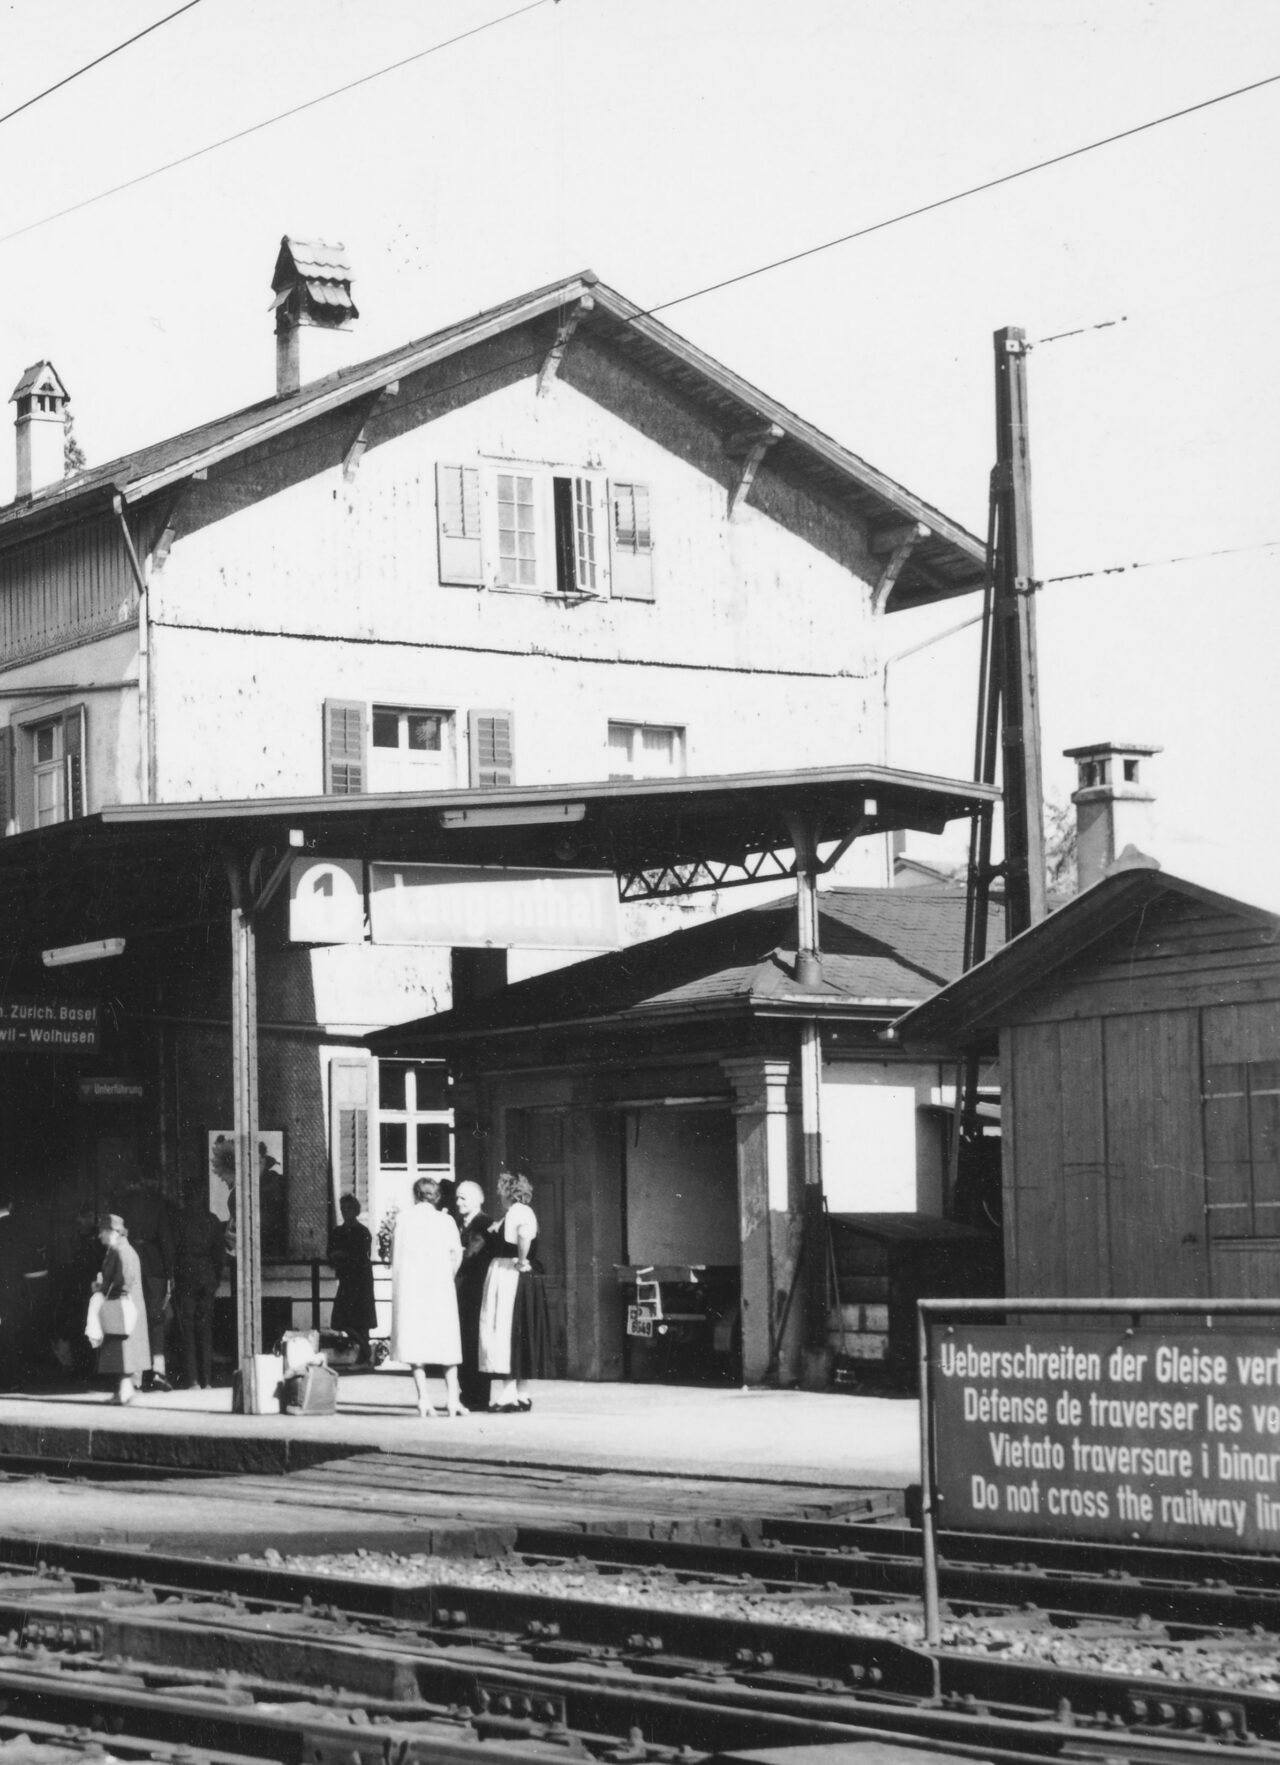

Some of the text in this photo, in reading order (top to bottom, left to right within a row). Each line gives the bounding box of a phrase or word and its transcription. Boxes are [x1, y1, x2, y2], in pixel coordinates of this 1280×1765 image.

[394, 872, 601, 937] Langenthal
[60, 1007, 96, 1020] Basel
[30, 1029, 95, 1044] Wolhusen
[94, 1083, 143, 1097] Unterführung
[941, 1344, 1280, 1386] Ueberschreiten der Gleise ver
[964, 1387, 1048, 1424] Défense
[1056, 1391, 1082, 1426] de
[1089, 1392, 1198, 1430] traverser
[1206, 1395, 1242, 1432] les
[989, 1432, 1064, 1470] Vietato
[1072, 1437, 1193, 1478] traversare
[1201, 1443, 1209, 1478] i
[971, 1475, 999, 1510] Do
[1006, 1480, 1040, 1513] not
[1047, 1485, 1109, 1518] cross
[1116, 1485, 1153, 1521] the
[1161, 1490, 1246, 1536] railway
